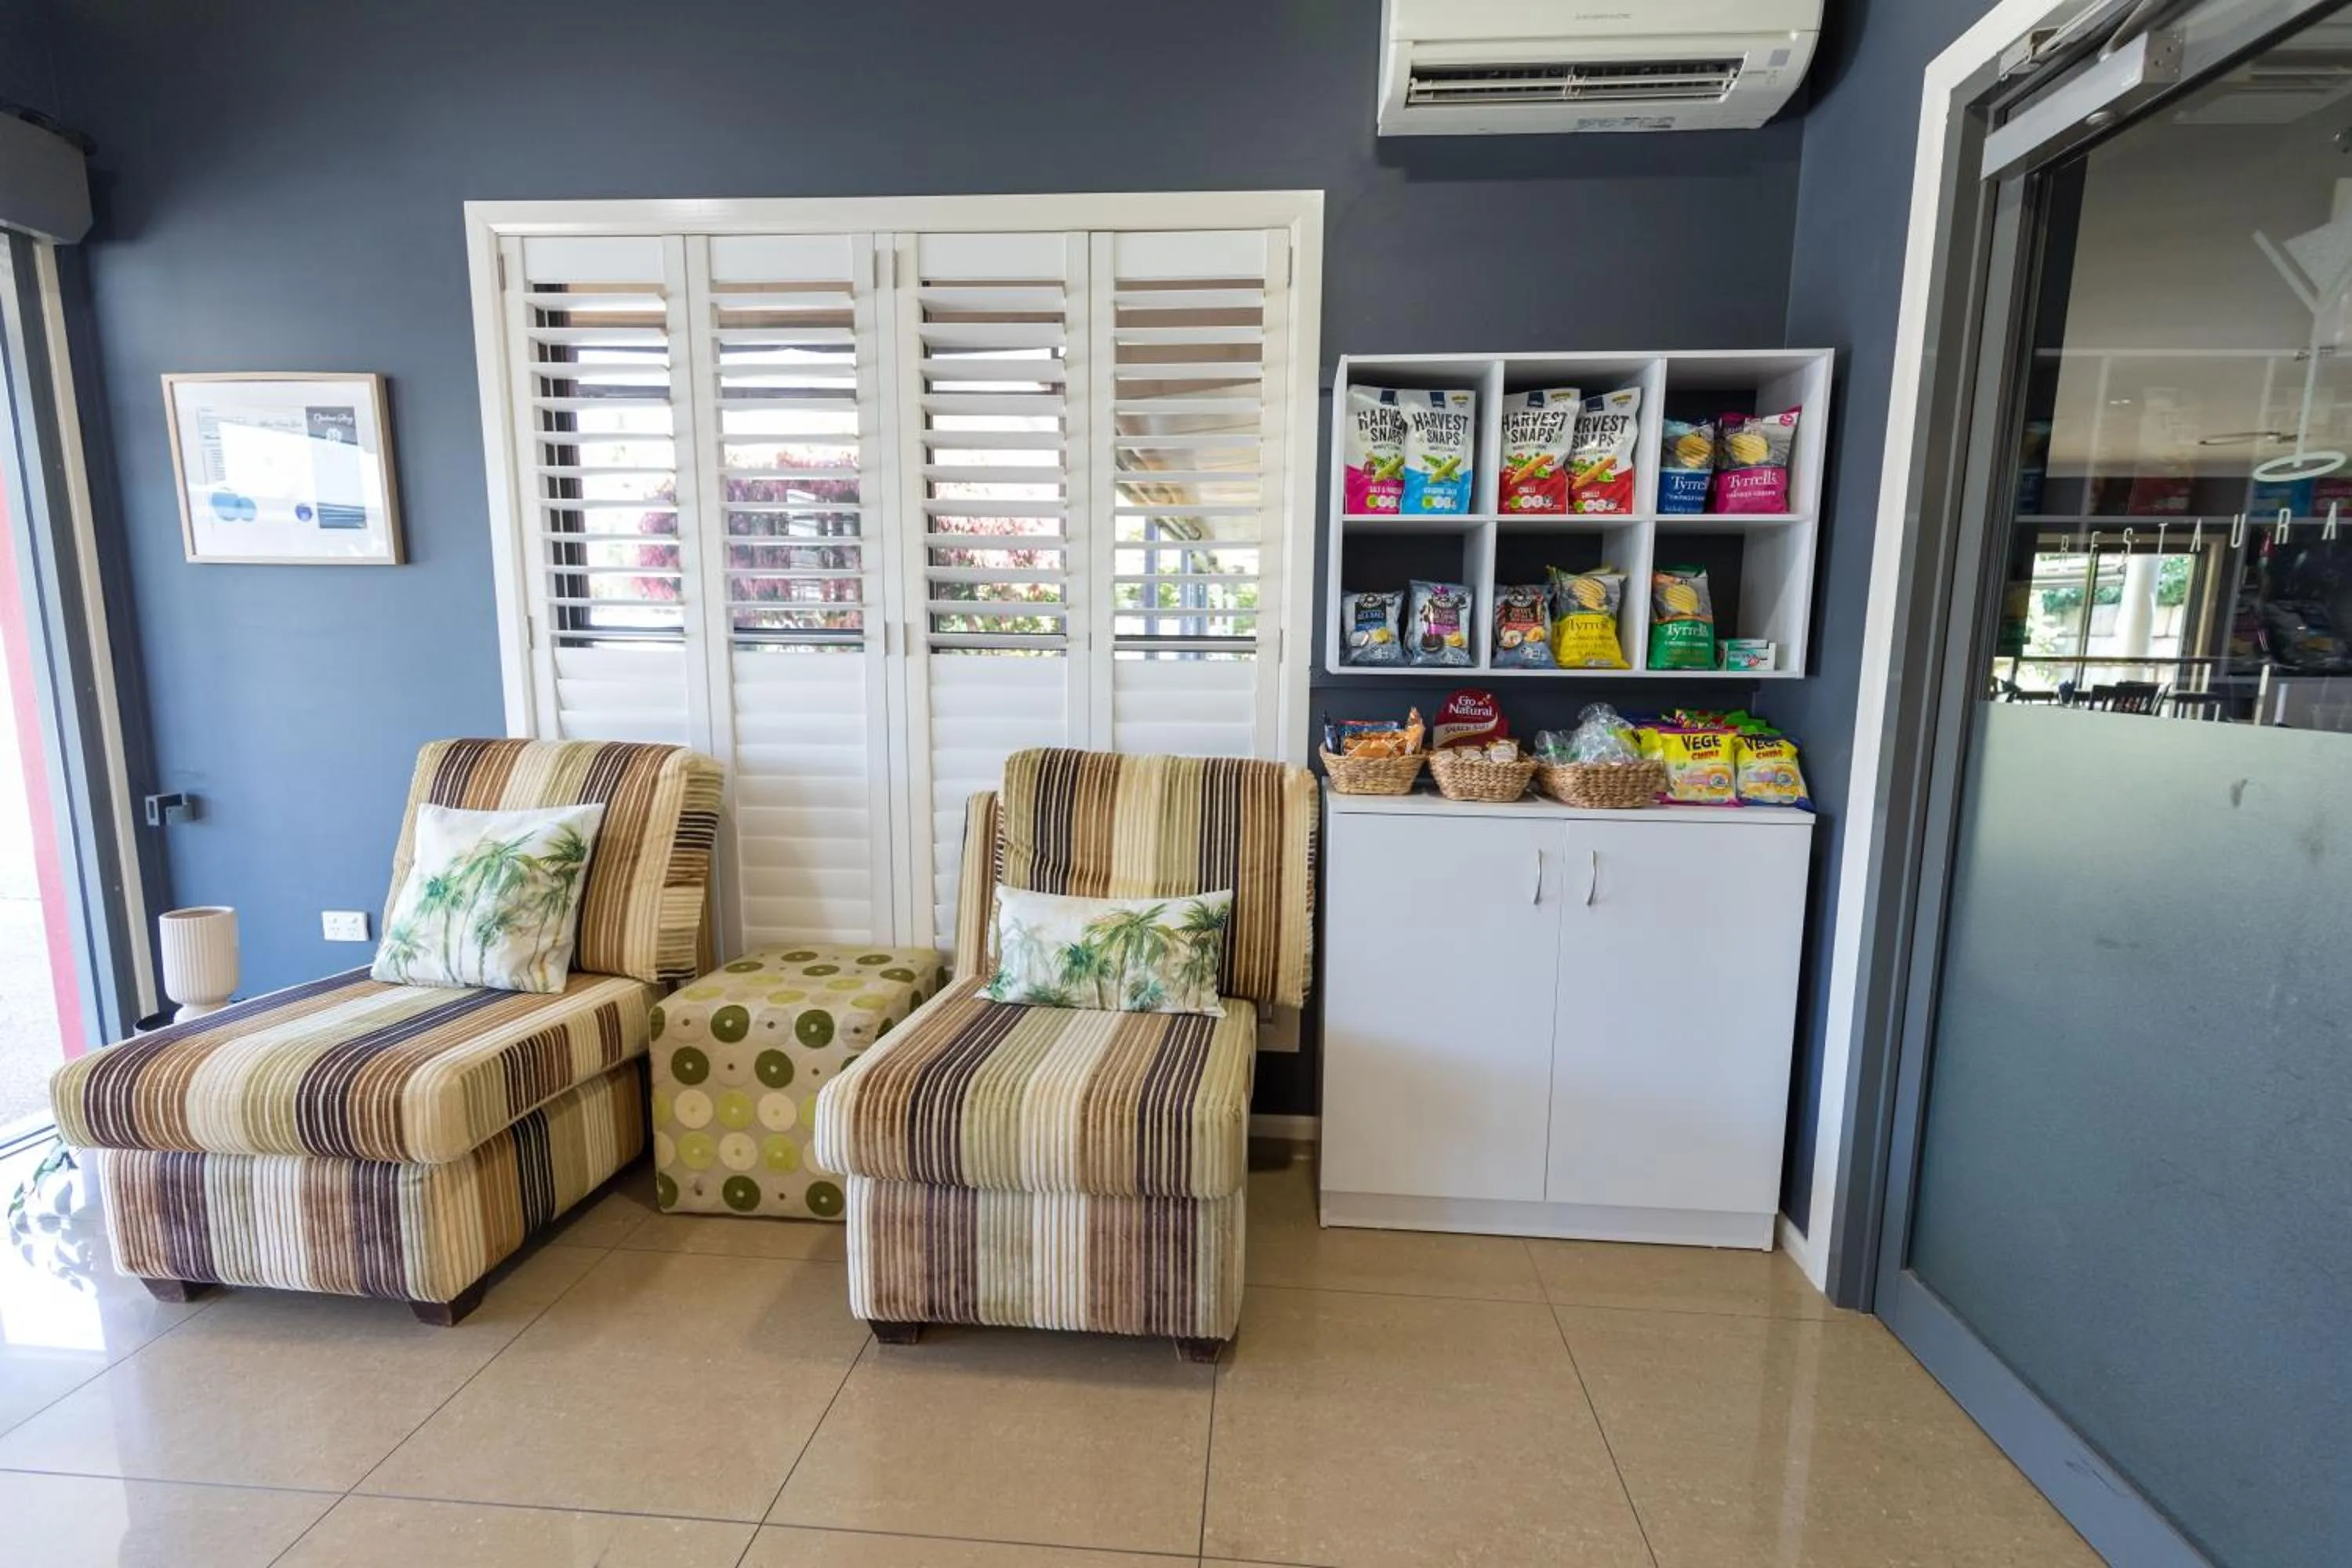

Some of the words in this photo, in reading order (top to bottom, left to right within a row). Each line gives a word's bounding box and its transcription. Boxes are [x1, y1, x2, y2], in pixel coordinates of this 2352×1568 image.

[1412, 412, 1468, 435] HARVEST
[1501, 412, 1567, 432] HARVEST
[1426, 429, 1460, 446] SNAPS
[1511, 427, 1555, 443] SNAPS
[1457, 695, 1476, 706] Go
[1448, 702, 1493, 716] Natural
[1681, 734, 1722, 752] VEGE
[1691, 750, 1720, 760] CHIPS
